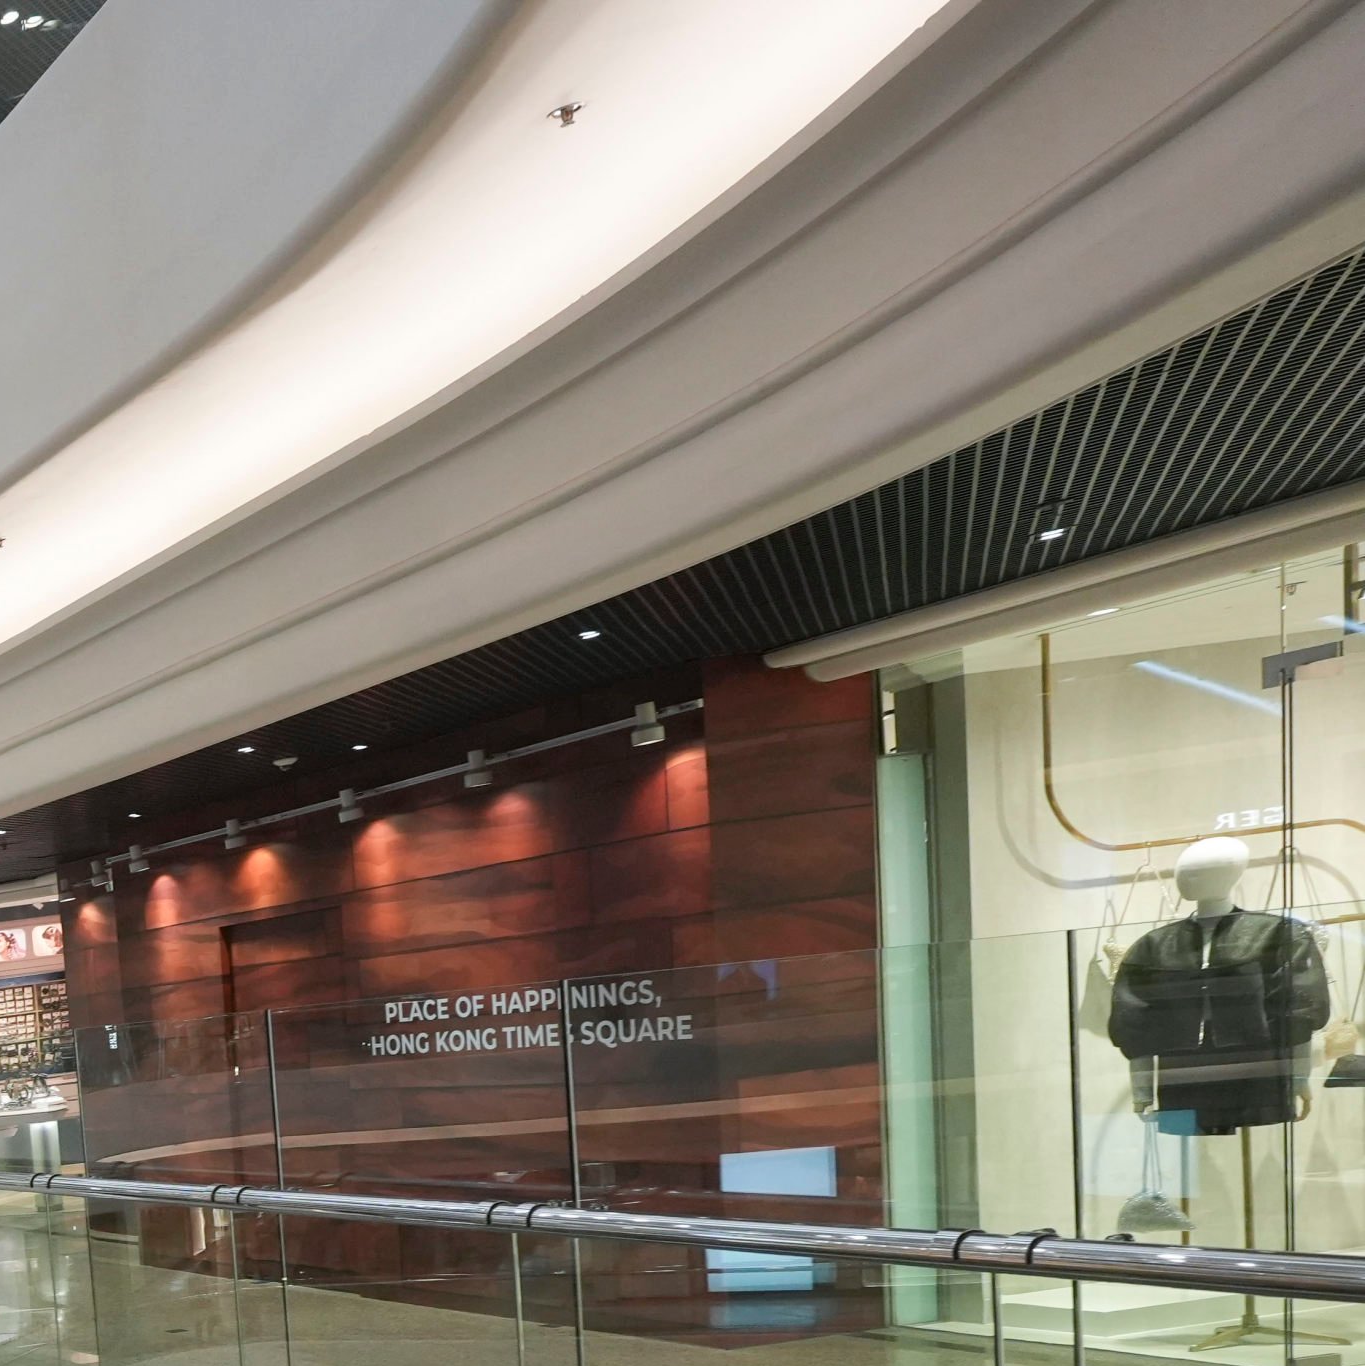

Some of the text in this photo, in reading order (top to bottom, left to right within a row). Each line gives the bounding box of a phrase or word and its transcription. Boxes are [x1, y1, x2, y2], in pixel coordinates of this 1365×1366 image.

[384, 979, 662, 1024] PLACE OF HAPPNINGS,
[371, 1031, 430, 1056] HONG
[435, 1028, 498, 1053] KONG
[580, 1014, 695, 1049] SQUARE
